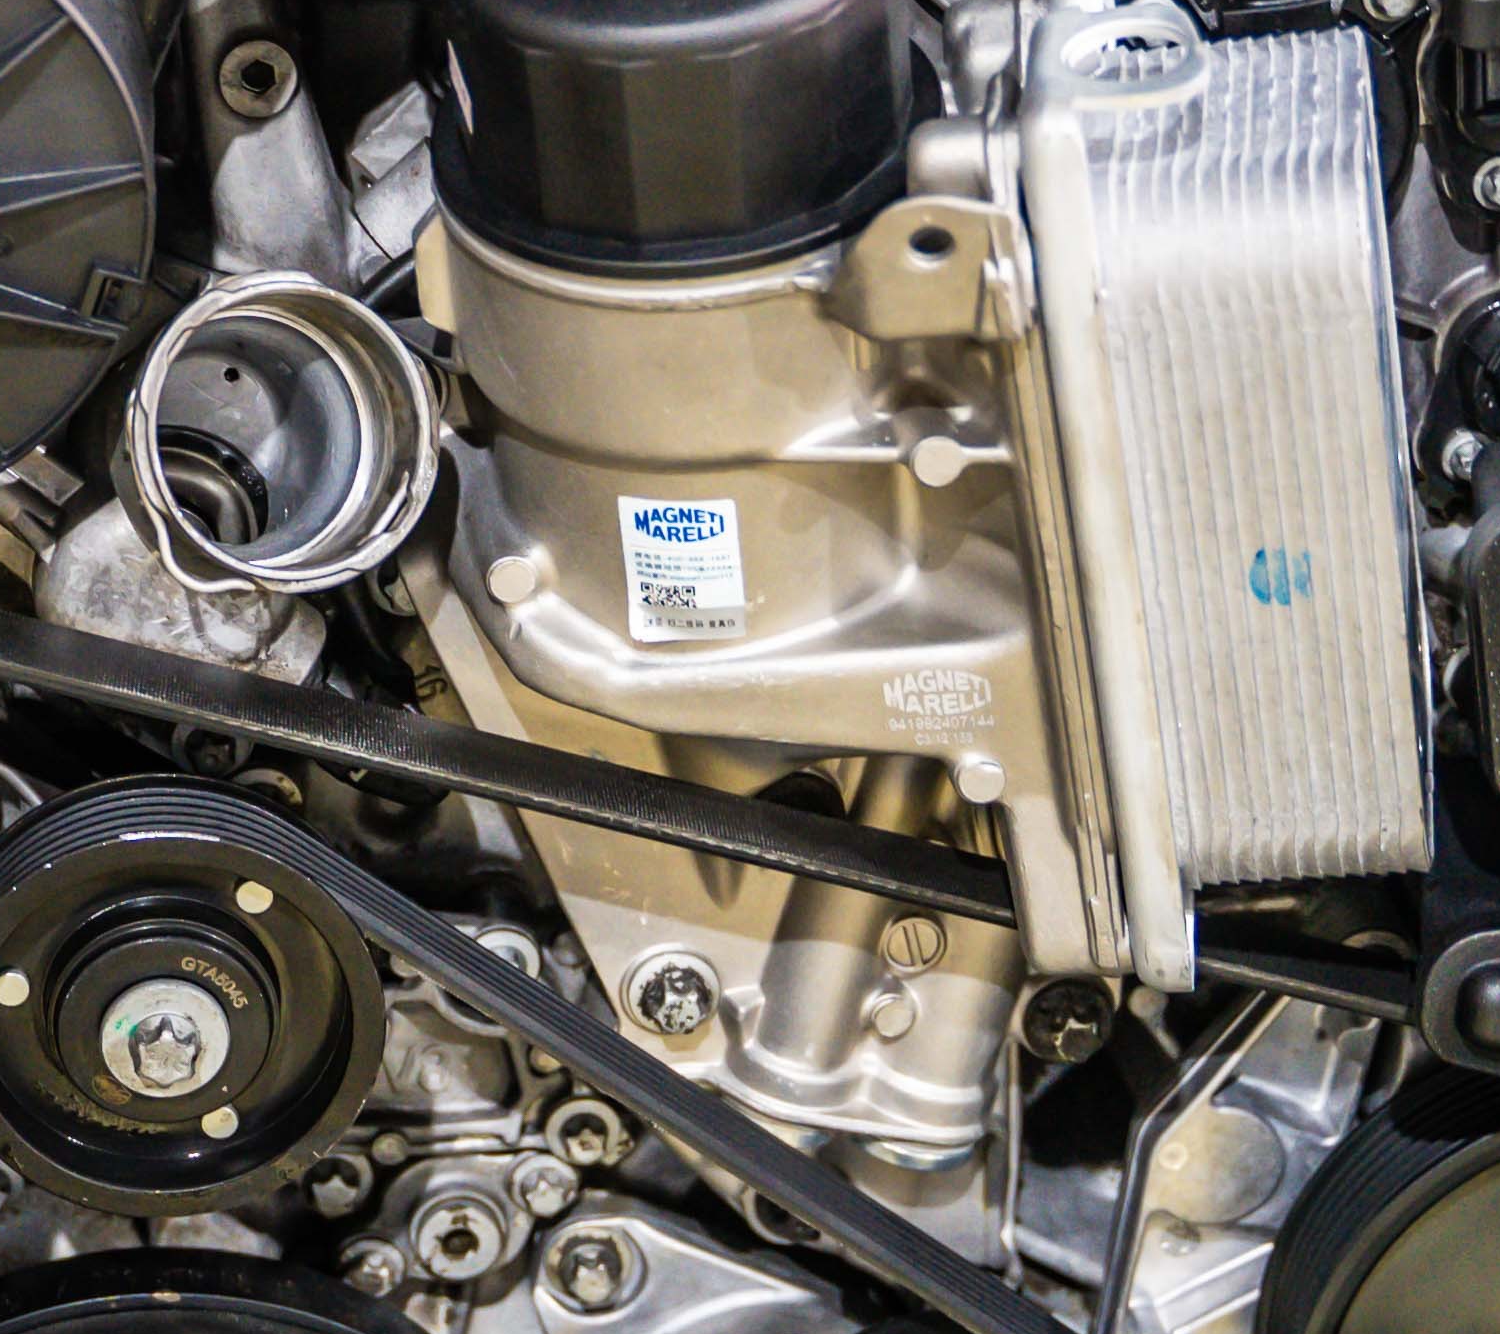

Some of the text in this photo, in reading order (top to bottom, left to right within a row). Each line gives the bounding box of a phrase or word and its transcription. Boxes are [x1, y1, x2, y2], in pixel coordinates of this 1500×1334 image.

[634, 507, 724, 529] MAGNETI
[634, 523, 724, 543] MARELLI
[883, 669, 992, 696] MAGNETI
[883, 689, 992, 715] MARELLI
[181, 956, 249, 1009] GTA5045
